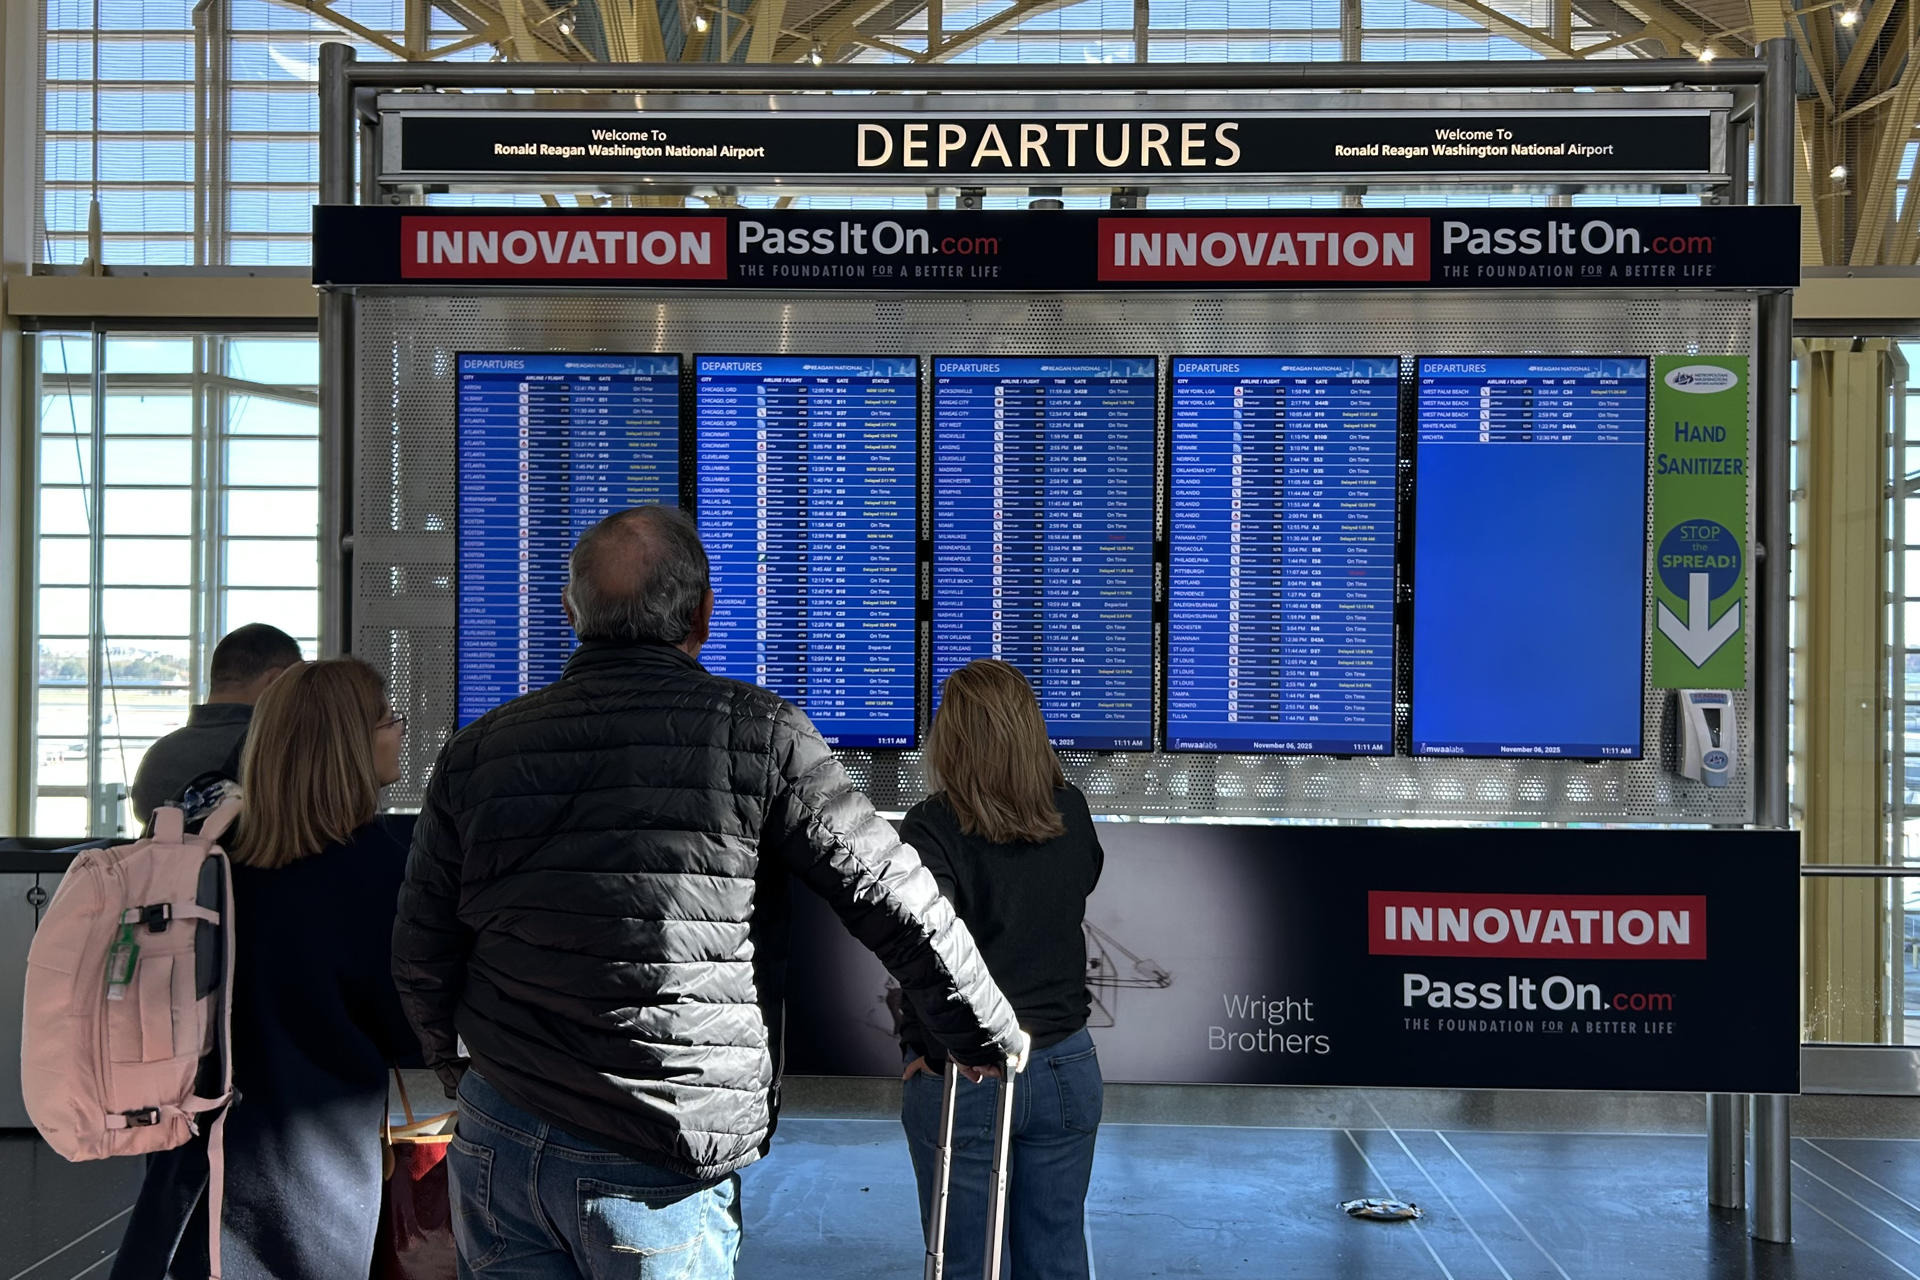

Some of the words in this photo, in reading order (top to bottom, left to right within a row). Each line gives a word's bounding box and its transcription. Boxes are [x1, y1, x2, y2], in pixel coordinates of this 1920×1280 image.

[592, 129, 648, 141] Welcome
[651, 130, 667, 141] To
[1435, 128, 1492, 140] Welcome
[1496, 129, 1513, 140] To
[857, 122, 1240, 167] DEPARTURES
[1335, 144, 1379, 156] Ronald
[1382, 144, 1428, 158] Reagan
[1431, 144, 1508, 158] Washington
[1511, 143, 1564, 156] National
[1567, 143, 1613, 157] Airport
[494, 143, 537, 156] Ronald
[540, 144, 585, 158] Reagan
[588, 144, 662, 159] Washington
[665, 145, 717, 157] National
[720, 145, 765, 160] Airport
[417, 230, 711, 265] INNOVATION
[1114, 232, 1414, 267] INNOVATION
[739, 264, 764, 276] THE
[773, 265, 865, 277] FOUNDATION
[872, 265, 893, 277] FOR
[900, 265, 908, 277] A
[915, 265, 963, 277] BETTER
[971, 265, 998, 277] LIFE
[1443, 265, 1469, 277] THE
[1478, 265, 1573, 277] FOUNDATION
[1581, 265, 1602, 277] FOR
[1610, 265, 1618, 277] A
[1625, 265, 1675, 277] BETTER
[1684, 265, 1712, 277] LIFE
[464, 360, 525, 370] DEPARTURES
[702, 362, 762, 371] DEPARTURES
[940, 363, 1000, 373] DEPARTURES
[1178, 363, 1240, 373] DEPARTURES
[1424, 364, 1486, 373] DEPARTURES
[1675, 421, 1726, 442] HAND
[1657, 453, 1743, 475] SANITIZER
[1680, 526, 1721, 539] STOP
[1692, 543, 1708, 551] the
[1662, 555, 1737, 568] SPREAD!
[1286, 742, 1296, 750] 06,
[1533, 746, 1544, 754] 06,
[1385, 906, 1690, 945] INNOVATION
[1222, 992, 1314, 1026] Wright
[1404, 1018, 1429, 1031] THE
[1438, 1019, 1534, 1032] FOUNDATION
[1542, 1021, 1563, 1033] FOR
[1571, 1021, 1579, 1033] A
[1586, 1021, 1636, 1034] BETTER
[1644, 1021, 1672, 1034] LIFE
[1206, 1024, 1330, 1056] Brothers
